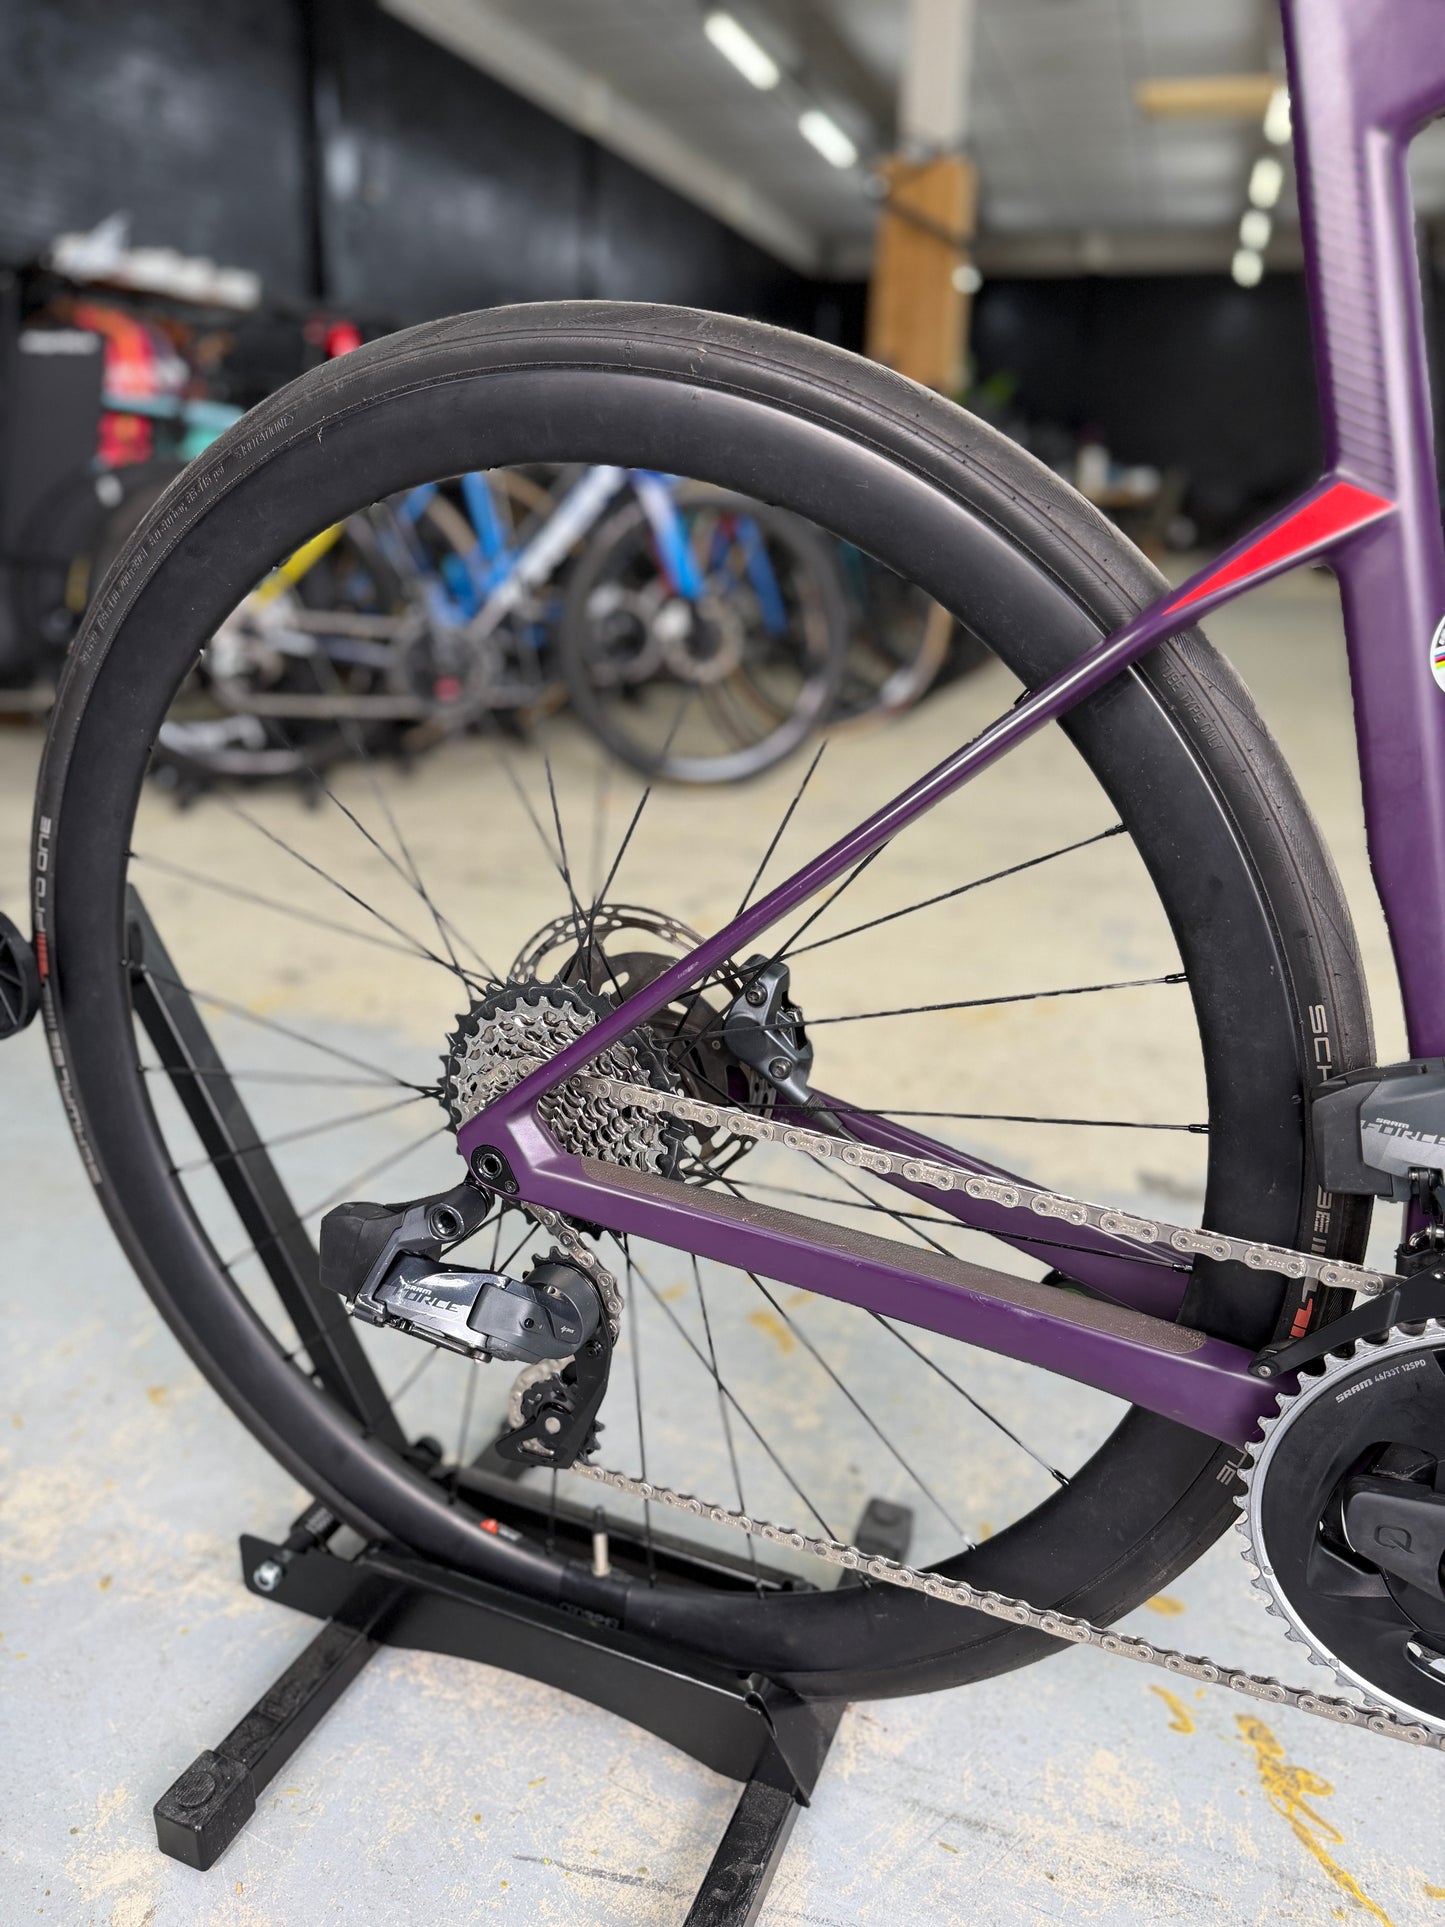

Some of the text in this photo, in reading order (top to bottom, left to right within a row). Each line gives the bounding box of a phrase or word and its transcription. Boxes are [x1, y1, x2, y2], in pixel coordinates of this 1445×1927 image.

[35, 816, 52, 932] PRO ONE
[1376, 1117, 1410, 1129] SRAM
[1335, 1378, 1373, 1403] SRAM
[1401, 1359, 1426, 1372] 12SPD
